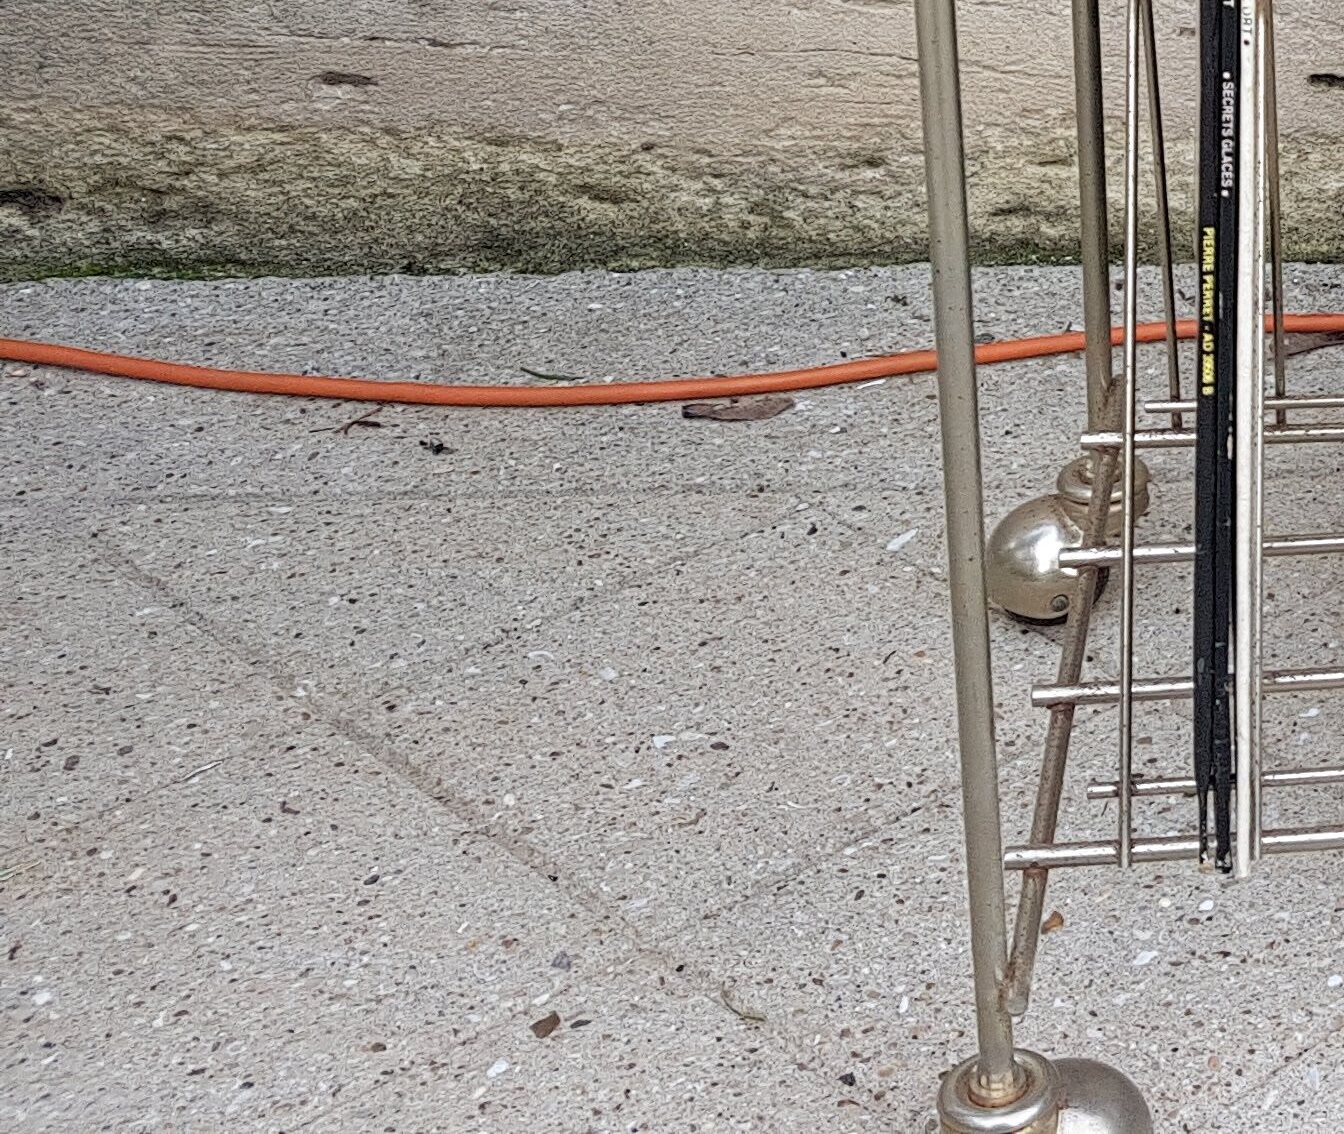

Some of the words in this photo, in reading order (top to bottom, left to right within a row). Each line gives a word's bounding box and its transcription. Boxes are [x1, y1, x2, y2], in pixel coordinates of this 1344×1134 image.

[1221, 81, 1234, 137] SECRETS
[1202, 227, 1215, 271] PIERRE
[1202, 274, 1215, 322] PERRET
[1203, 332, 1214, 352] AD
